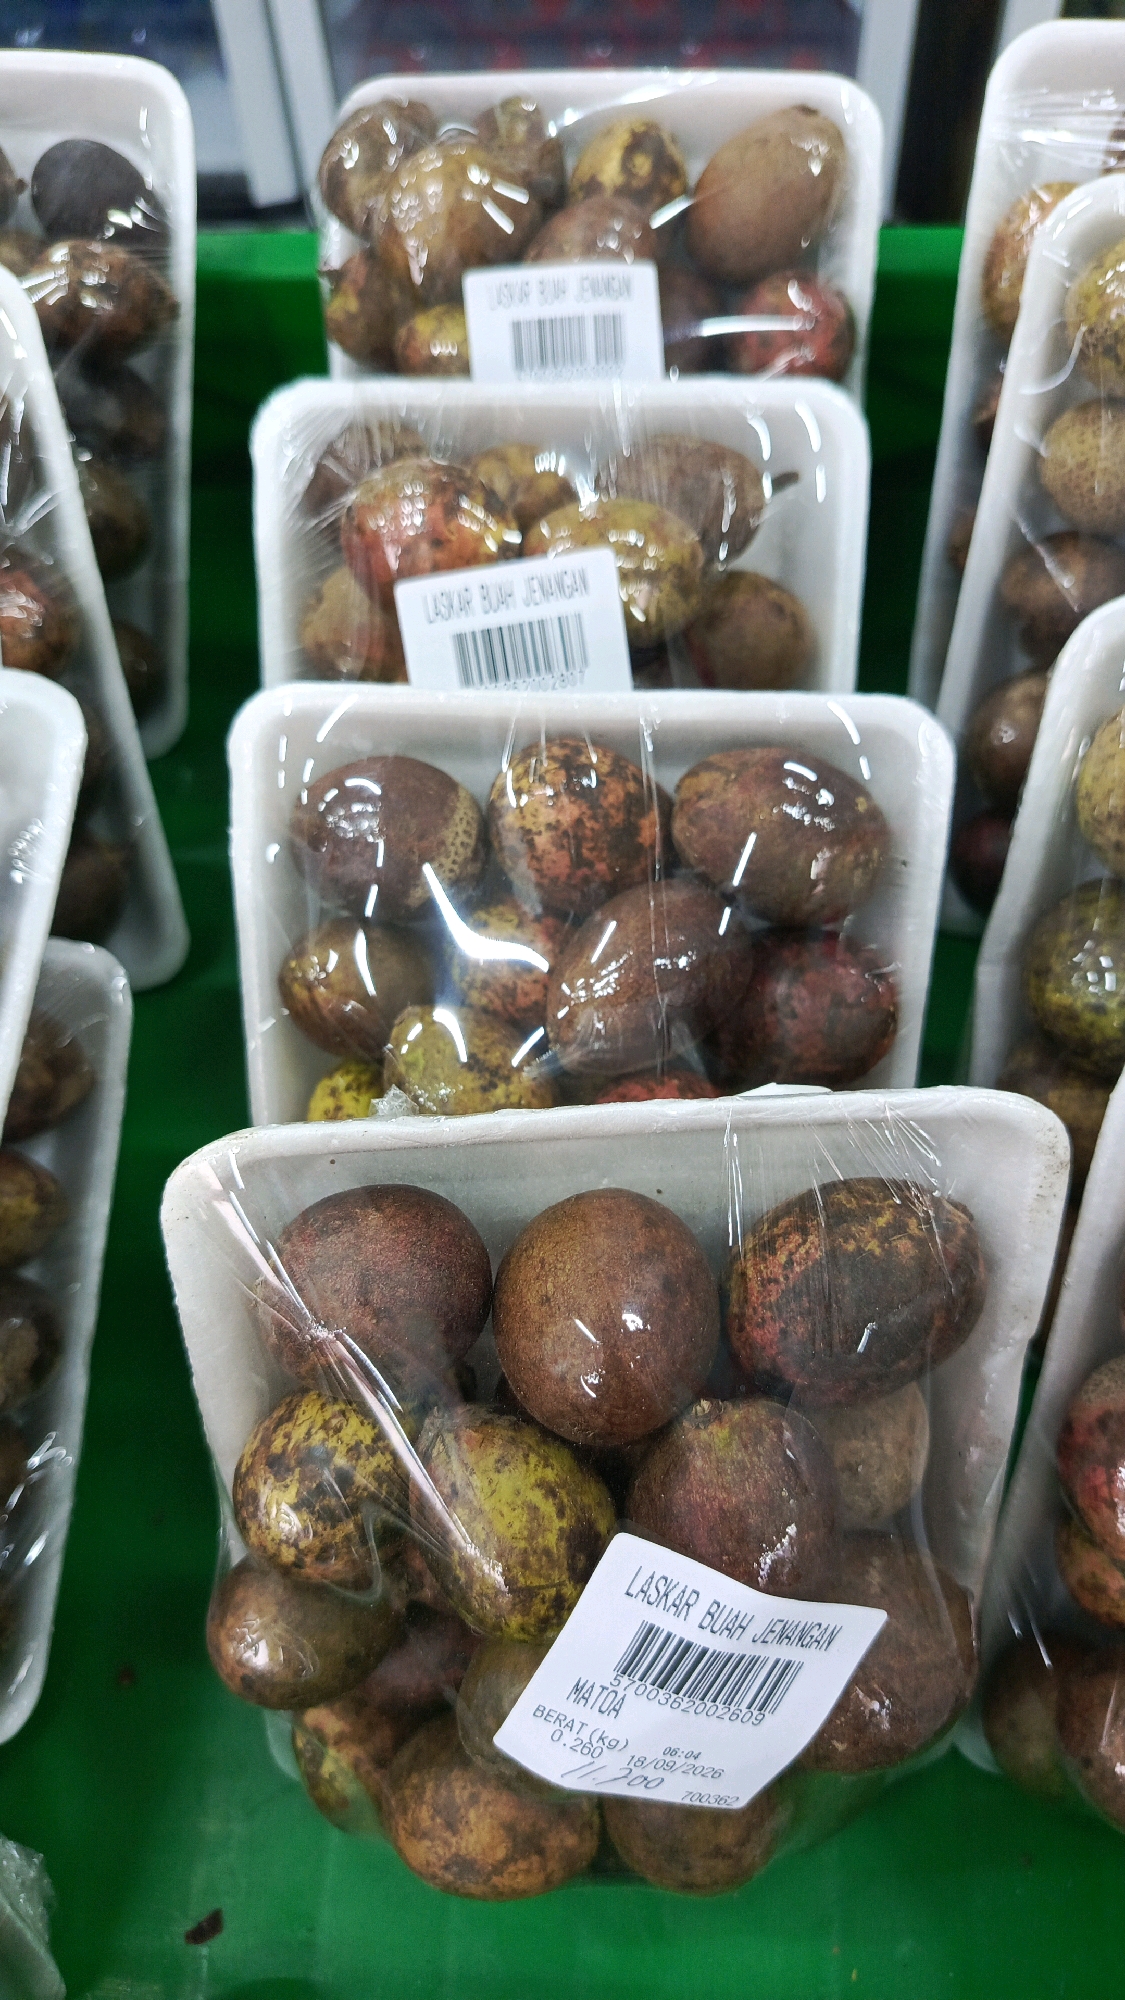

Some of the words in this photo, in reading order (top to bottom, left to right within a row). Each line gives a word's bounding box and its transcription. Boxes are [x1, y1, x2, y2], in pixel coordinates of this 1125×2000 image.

[422, 585, 475, 624] LASKAR
[478, 580, 517, 615] BUAH
[522, 566, 591, 608] JENANGAN
[624, 1565, 700, 1622] LASKAR
[697, 1599, 755, 1641] BUAH
[752, 1617, 843, 1652] JENANGAN
[566, 1676, 627, 1719] MATOA
[609, 1673, 766, 1726] 5700362002609
[550, 1728, 603, 1760] 0.260
[663, 1746, 702, 1761] 06:04
[626, 1754, 725, 1780] 18/09/2026
[681, 1791, 740, 1807] 700362
